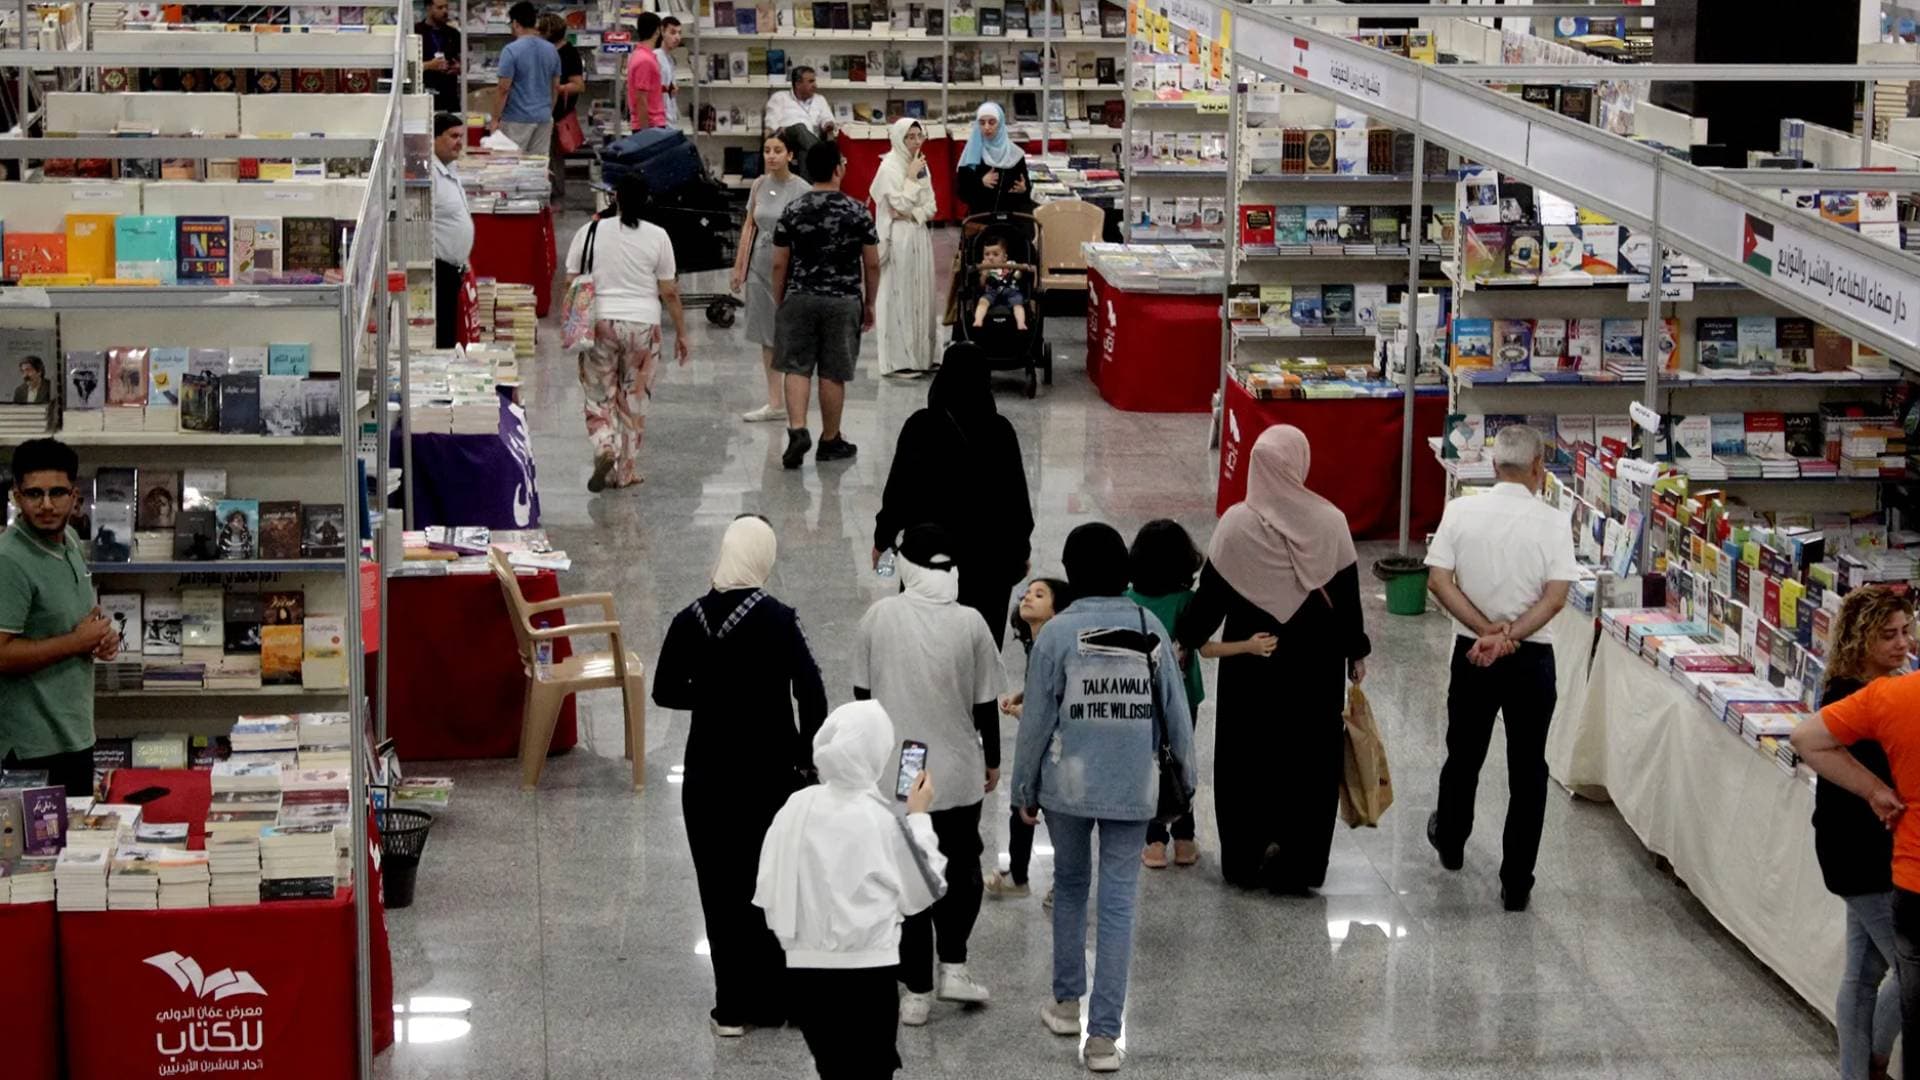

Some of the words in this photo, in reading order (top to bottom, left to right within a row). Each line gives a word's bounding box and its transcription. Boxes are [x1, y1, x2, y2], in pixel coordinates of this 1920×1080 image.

[1777, 243, 1806, 283] والتوزيع
[1807, 253, 1834, 296] والنشر
[1835, 265, 1868, 306] للطباعة
[1868, 279, 1893, 315] صفاء
[1893, 291, 1906, 324] دار
[1082, 677, 1109, 696] TALK
[1110, 678, 1119, 695] A
[1120, 677, 1150, 695] WALK
[1069, 703, 1084, 719] ON
[1087, 702, 1109, 719] THE
[1110, 702, 1153, 719] WILDSID
[156, 1006, 195, 1022] الدولي
[226, 1005, 263, 1019] معرض
[156, 1020, 263, 1062] للكتاب
[200, 1058, 240, 1072] الناشرين
[241, 1058, 263, 1071] اتحاد
